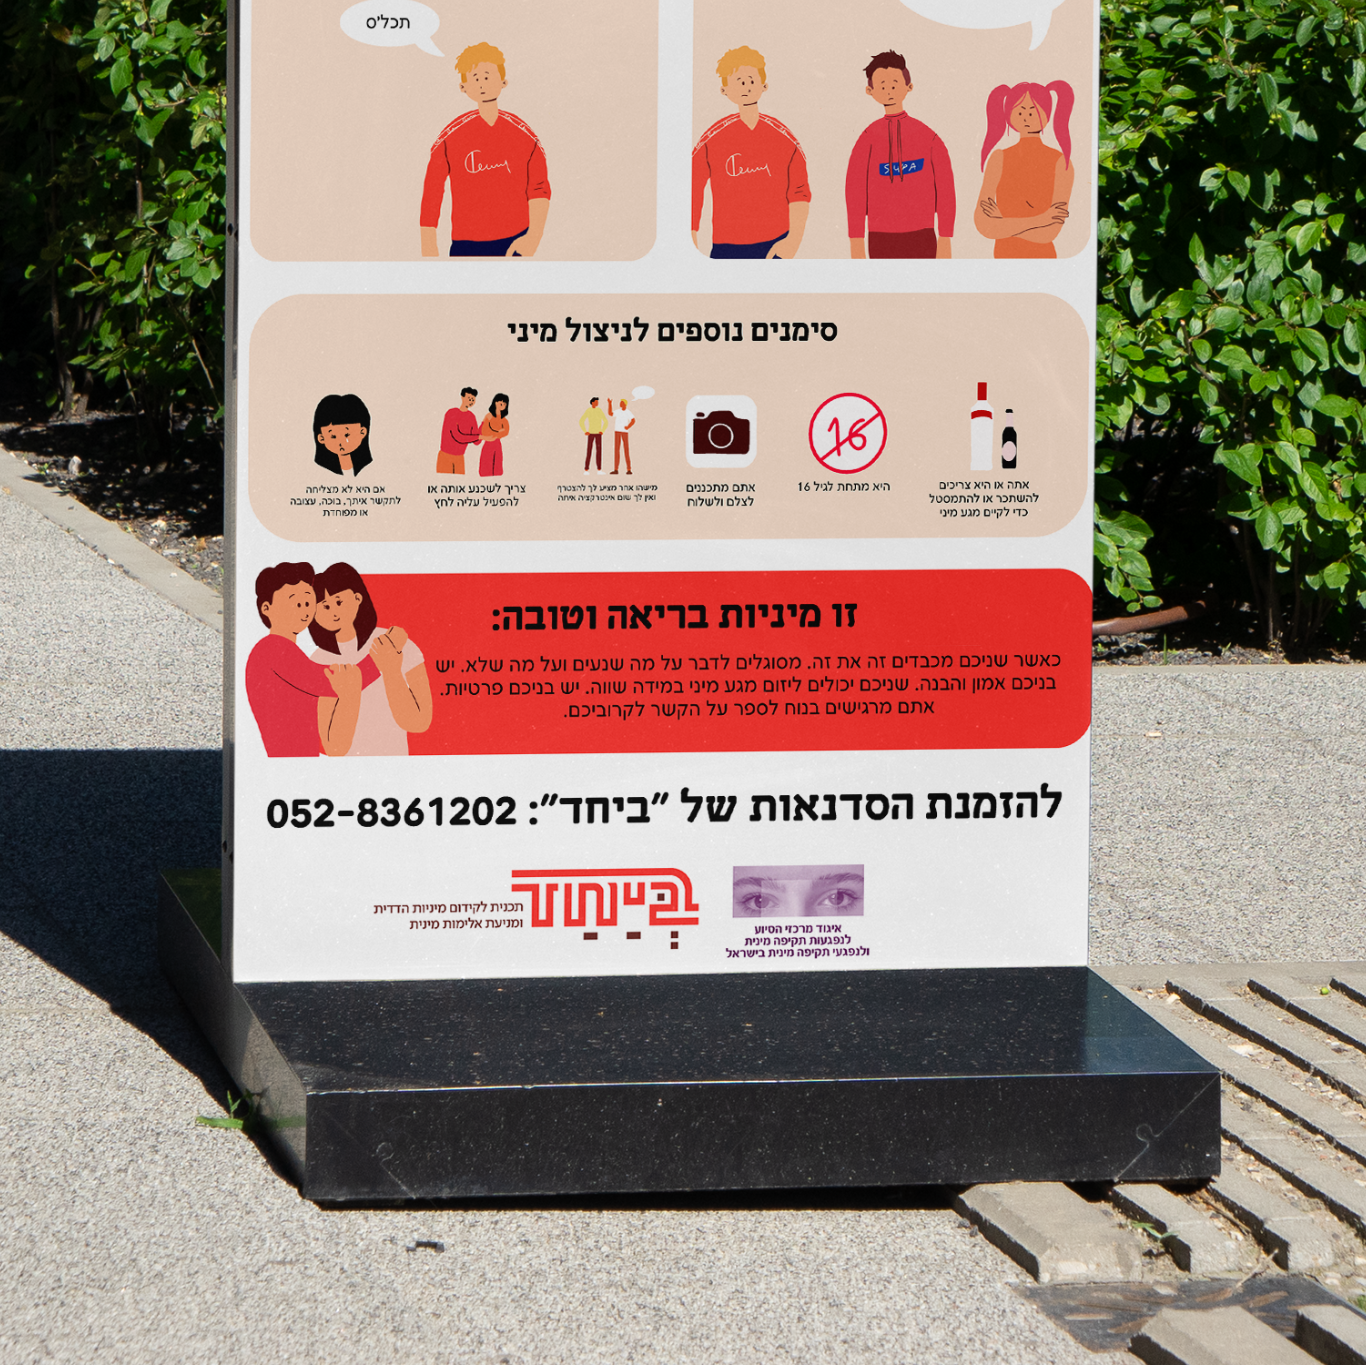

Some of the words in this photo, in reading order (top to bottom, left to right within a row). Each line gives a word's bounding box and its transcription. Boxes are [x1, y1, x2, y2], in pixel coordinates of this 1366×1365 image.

[507, 322, 557, 342] מיני
[565, 316, 649, 342] לניצול
[657, 322, 743, 341] נוספים
[751, 322, 837, 341] סימנים
[827, 416, 867, 456] 16
[305, 484, 338, 493] מצליחה
[341, 484, 353, 493] לא
[427, 485, 437, 493] או
[440, 485, 465, 493] אותה
[468, 483, 501, 493] לשכנע
[504, 484, 525, 495] צריך
[686, 483, 729, 492] מתכננים
[732, 483, 755, 492] אתם
[798, 481, 810, 491] 16
[813, 480, 833, 491] לגיל
[836, 482, 869, 491] מתחת
[872, 482, 890, 491] היא
[939, 481, 971, 489] צריכים
[973, 481, 991, 489] היא
[994, 481, 1003, 489] או
[1007, 480, 1029, 489] אתה
[289, 497, 316, 505] עצובה
[318, 497, 341, 505] בוכה,
[343, 497, 367, 506] איתך,
[369, 495, 401, 505] לתקשר
[434, 496, 454, 509] לחץ
[456, 496, 479, 507] עליה
[482, 496, 519, 506] להפעיל
[687, 495, 723, 506] ולשלוח
[726, 495, 754, 506] לצלם
[928, 493, 980, 503] להתמסטל
[982, 495, 993, 503] או
[995, 492, 1039, 503] להשתכר
[322, 508, 357, 516] מפוחדת
[939, 508, 957, 517] מיני
[960, 508, 980, 517] מגע
[983, 506, 1009, 519] לקיים
[1012, 508, 1028, 517] כדי
[492, 605, 596, 631] וטובה:
[607, 604, 709, 629] בריאה
[718, 603, 821, 628] מיניות
[831, 603, 857, 627] זו
[680, 786, 737, 823] של
[925, 782, 1062, 819] להזמנת
[266, 795, 516, 828] 052-8361202
[749, 792, 913, 821] הסדנאות
[373, 904, 409, 914] הדדית
[412, 903, 446, 913] מיניות
[449, 900, 487, 914] לקידום
[490, 902, 523, 912] תכנית
[409, 919, 439, 929] מינית
[442, 917, 482, 929] אלימות
[485, 918, 523, 928] ומניעת
[754, 925, 782, 934] הסיוע
[784, 924, 813, 933] מרכזי
[815, 924, 841, 933] איגוד
[744, 937, 771, 946] מינית
[773, 936, 806, 947] תקיפה
[809, 935, 851, 945] לנפגעות
[725, 947, 765, 958] בישראל
[767, 948, 794, 957] מינית
[796, 947, 830, 959] תקיפה
[832, 946, 869, 956] ולנפגעי
